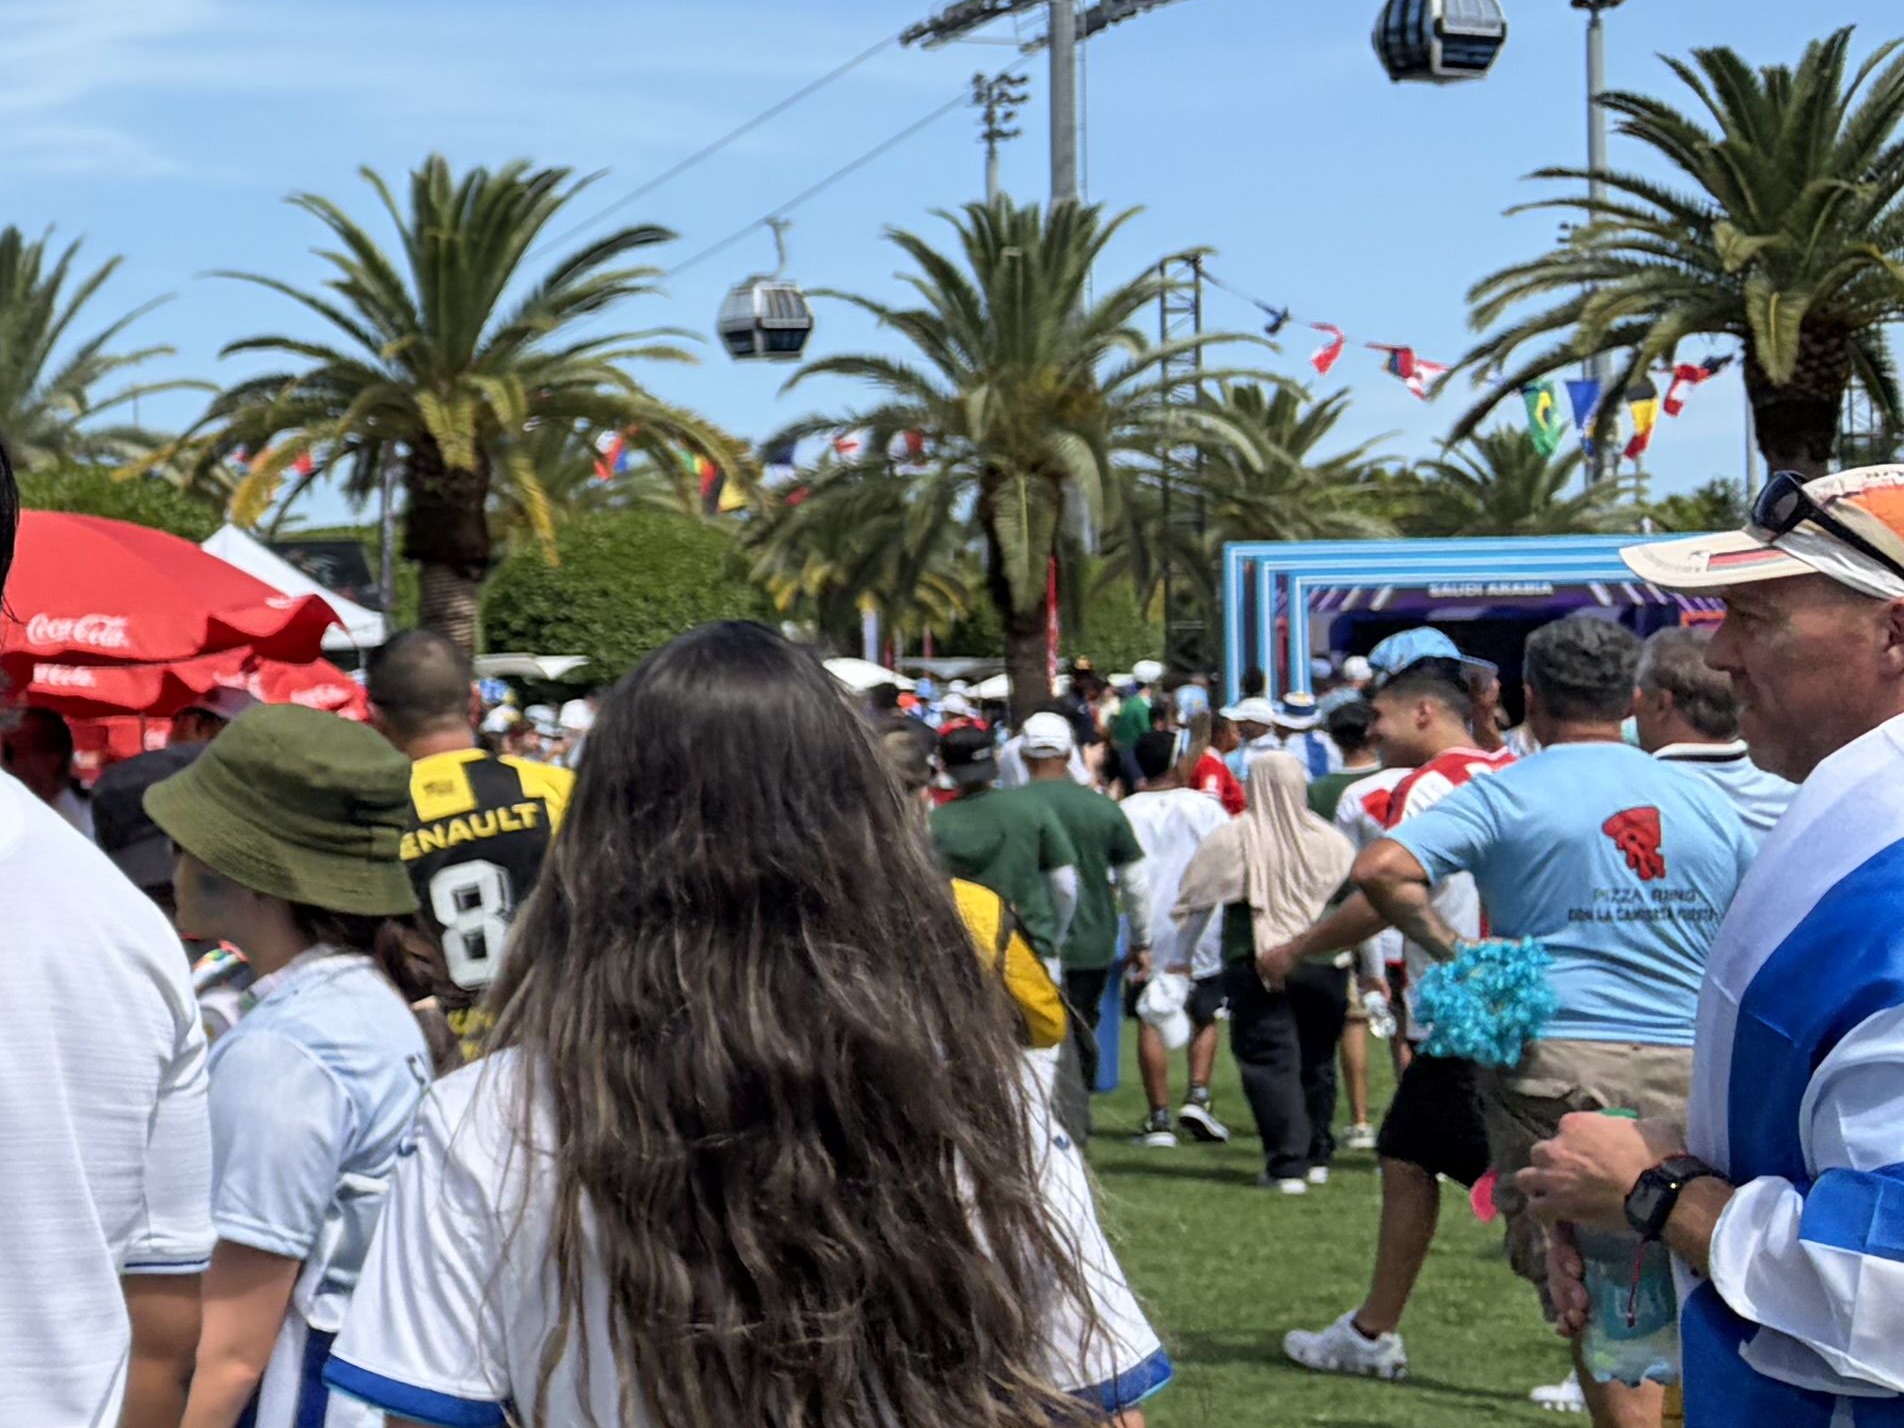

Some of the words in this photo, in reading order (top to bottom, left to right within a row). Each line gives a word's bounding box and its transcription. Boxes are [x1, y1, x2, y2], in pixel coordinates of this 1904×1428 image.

[1428, 581, 1484, 599] SAUDI
[1486, 580, 1555, 597] ARABIA
[399, 801, 540, 861] ENAULT
[429, 858, 512, 991] 8
